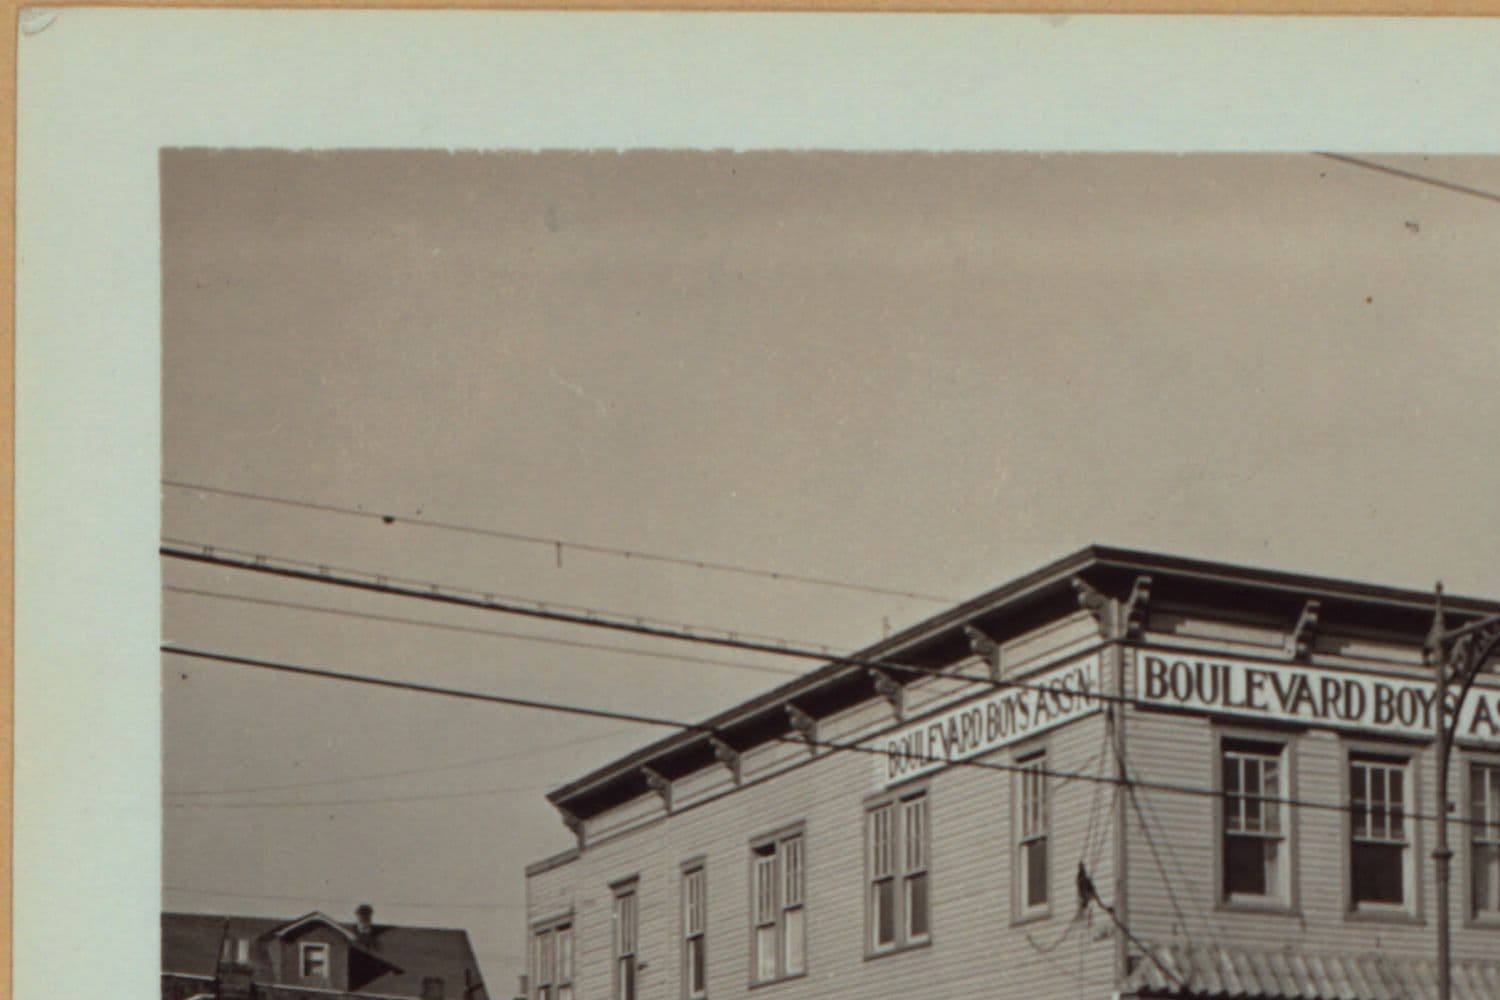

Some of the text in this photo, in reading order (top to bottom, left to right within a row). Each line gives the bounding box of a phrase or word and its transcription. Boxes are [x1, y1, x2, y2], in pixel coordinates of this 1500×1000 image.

[1144, 656, 1367, 721] BOULEVARD
[887, 707, 984, 779] BOULEVARD
[986, 684, 1031, 744] BOYS
